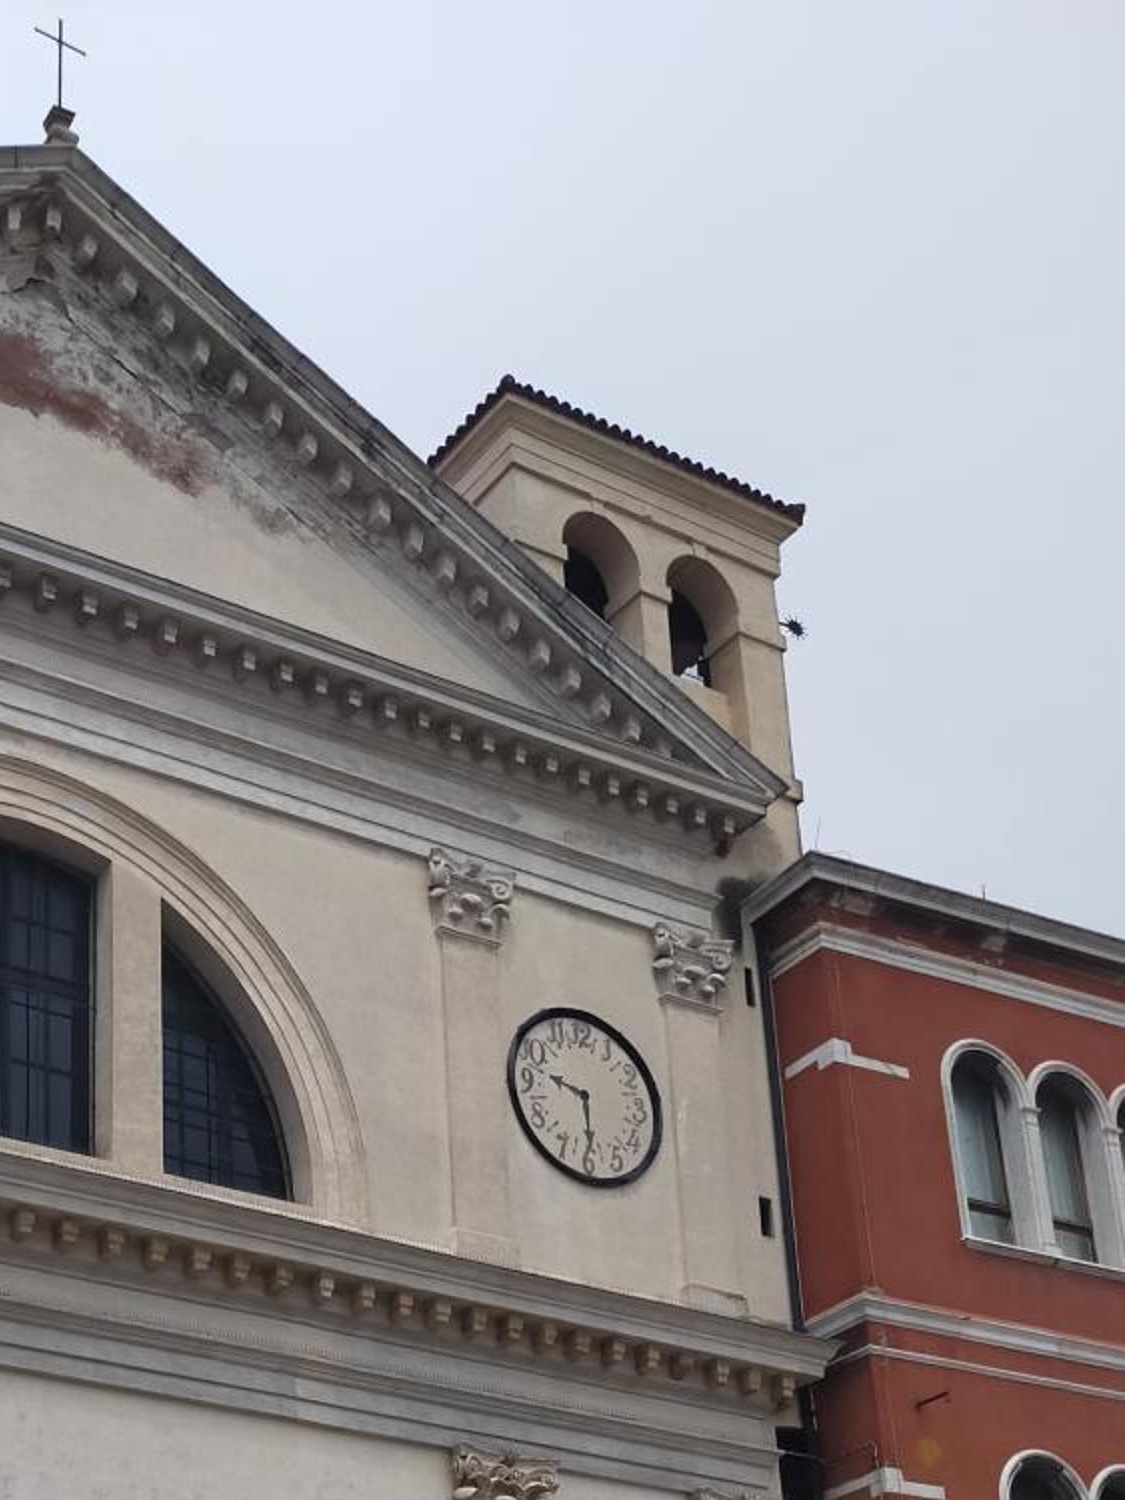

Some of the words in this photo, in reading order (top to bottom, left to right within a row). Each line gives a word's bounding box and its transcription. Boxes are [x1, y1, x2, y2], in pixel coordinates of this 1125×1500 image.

[571, 1022, 592, 1048] 12
[518, 1038, 545, 1066] 10
[520, 1067, 534, 1093] 9
[623, 1063, 637, 1089] 2
[531, 1102, 545, 1128] 8
[633, 1098, 647, 1124] 3
[556, 1132, 569, 1160] 7
[626, 1128, 641, 1154] 4
[583, 1148, 595, 1175] 6
[609, 1146, 623, 1172] 5
